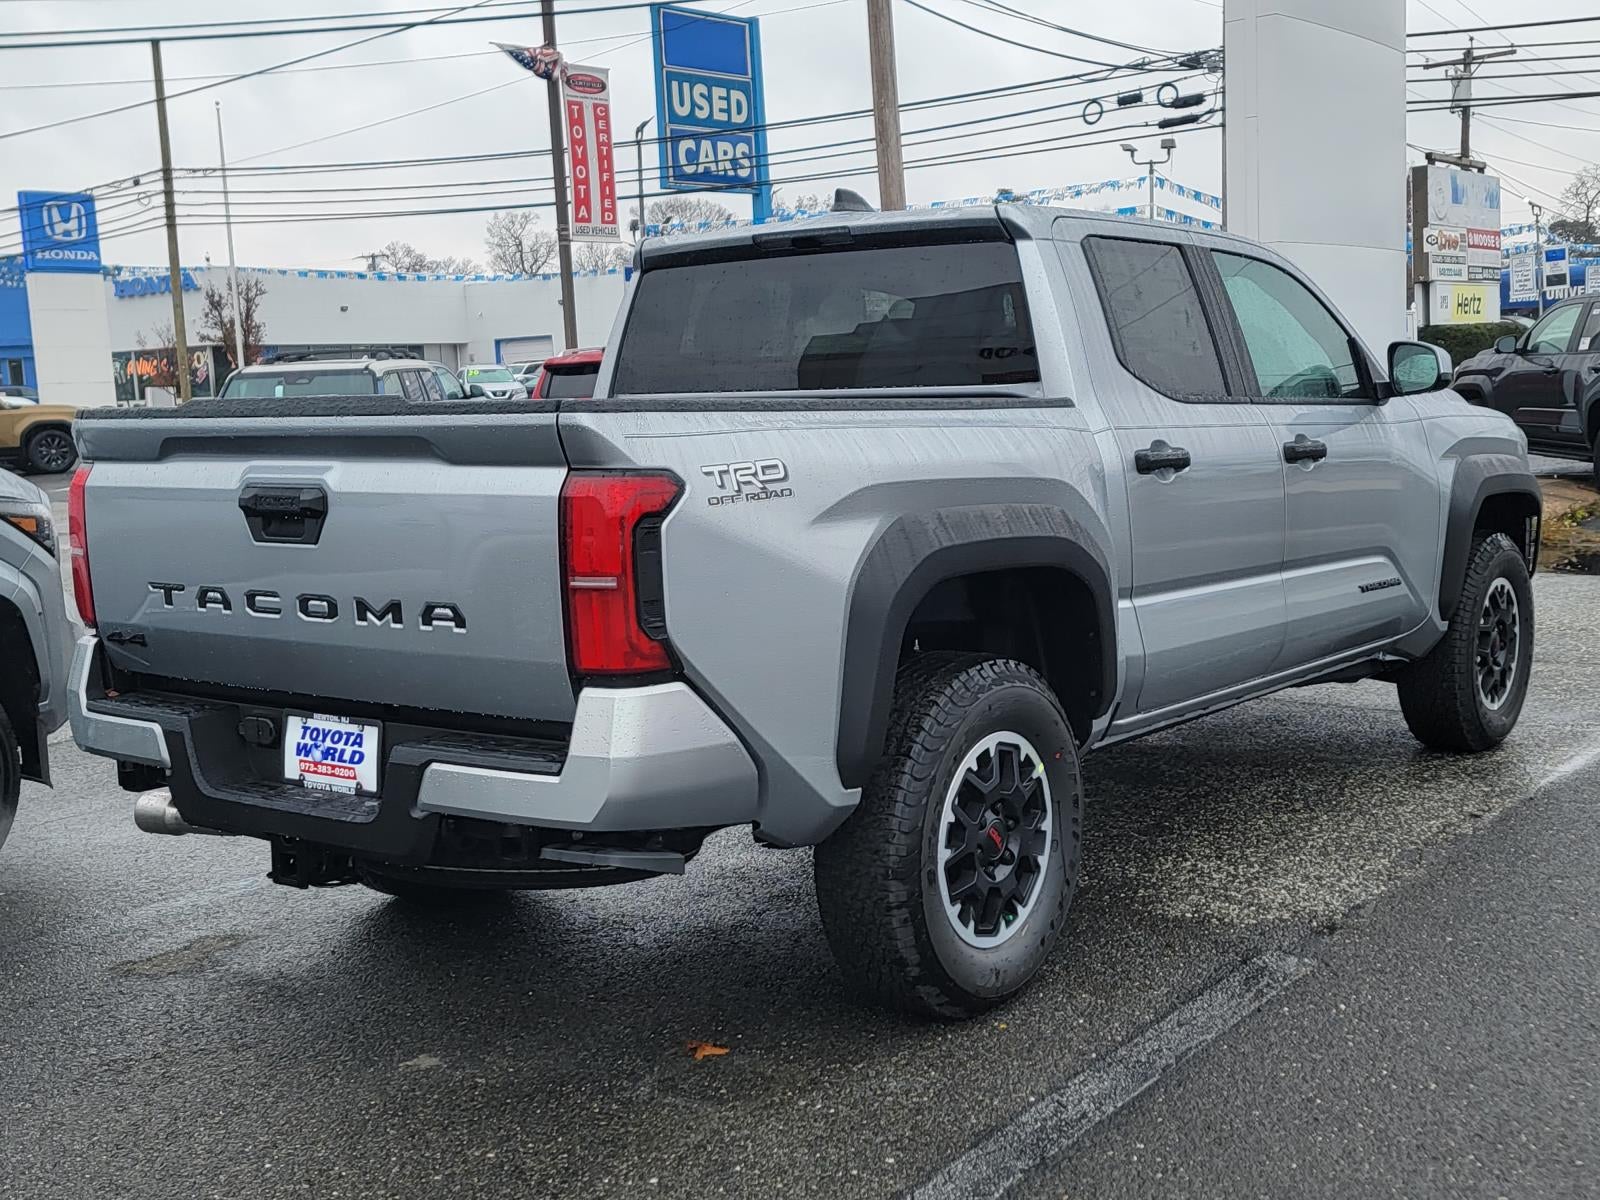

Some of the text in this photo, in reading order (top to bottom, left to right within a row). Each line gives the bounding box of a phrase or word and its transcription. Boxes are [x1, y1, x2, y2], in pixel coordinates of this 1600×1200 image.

[671, 80, 748, 124] USED
[571, 105, 588, 219] TOYOTA
[596, 106, 614, 221] CERTIFIED
[678, 139, 751, 178] CARS
[575, 225, 617, 236] USED VEHICLES
[1473, 231, 1495, 248] MOOSE
[36, 249, 98, 260] HONDA
[1456, 293, 1481, 315] Hertz
[700, 457, 789, 493] TRD
[708, 487, 793, 506] OFF ROAD
[148, 581, 467, 633] TACOMA
[301, 726, 364, 748] TOYOTA
[295, 742, 365, 765] WORLD
[303, 781, 356, 795] TOYOTA WORLD
